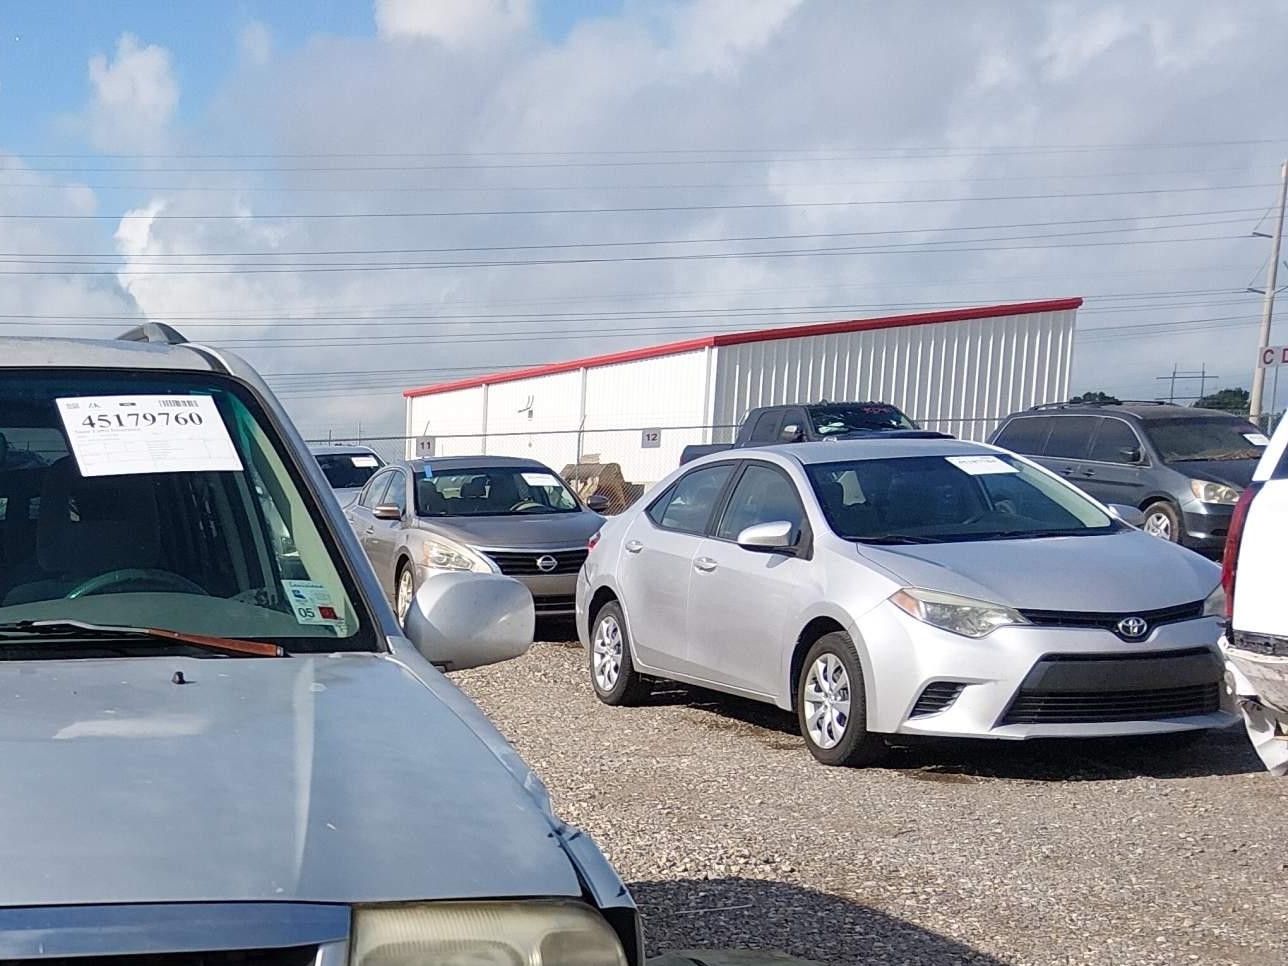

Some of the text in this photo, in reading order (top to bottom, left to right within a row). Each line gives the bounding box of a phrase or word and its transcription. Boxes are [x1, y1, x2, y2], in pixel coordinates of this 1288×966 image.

[1263, 348, 1274, 365] C
[82, 412, 203, 428] 45179760
[646, 433, 658, 441] 12
[420, 441, 431, 450] 11
[298, 607, 315, 618] 05
